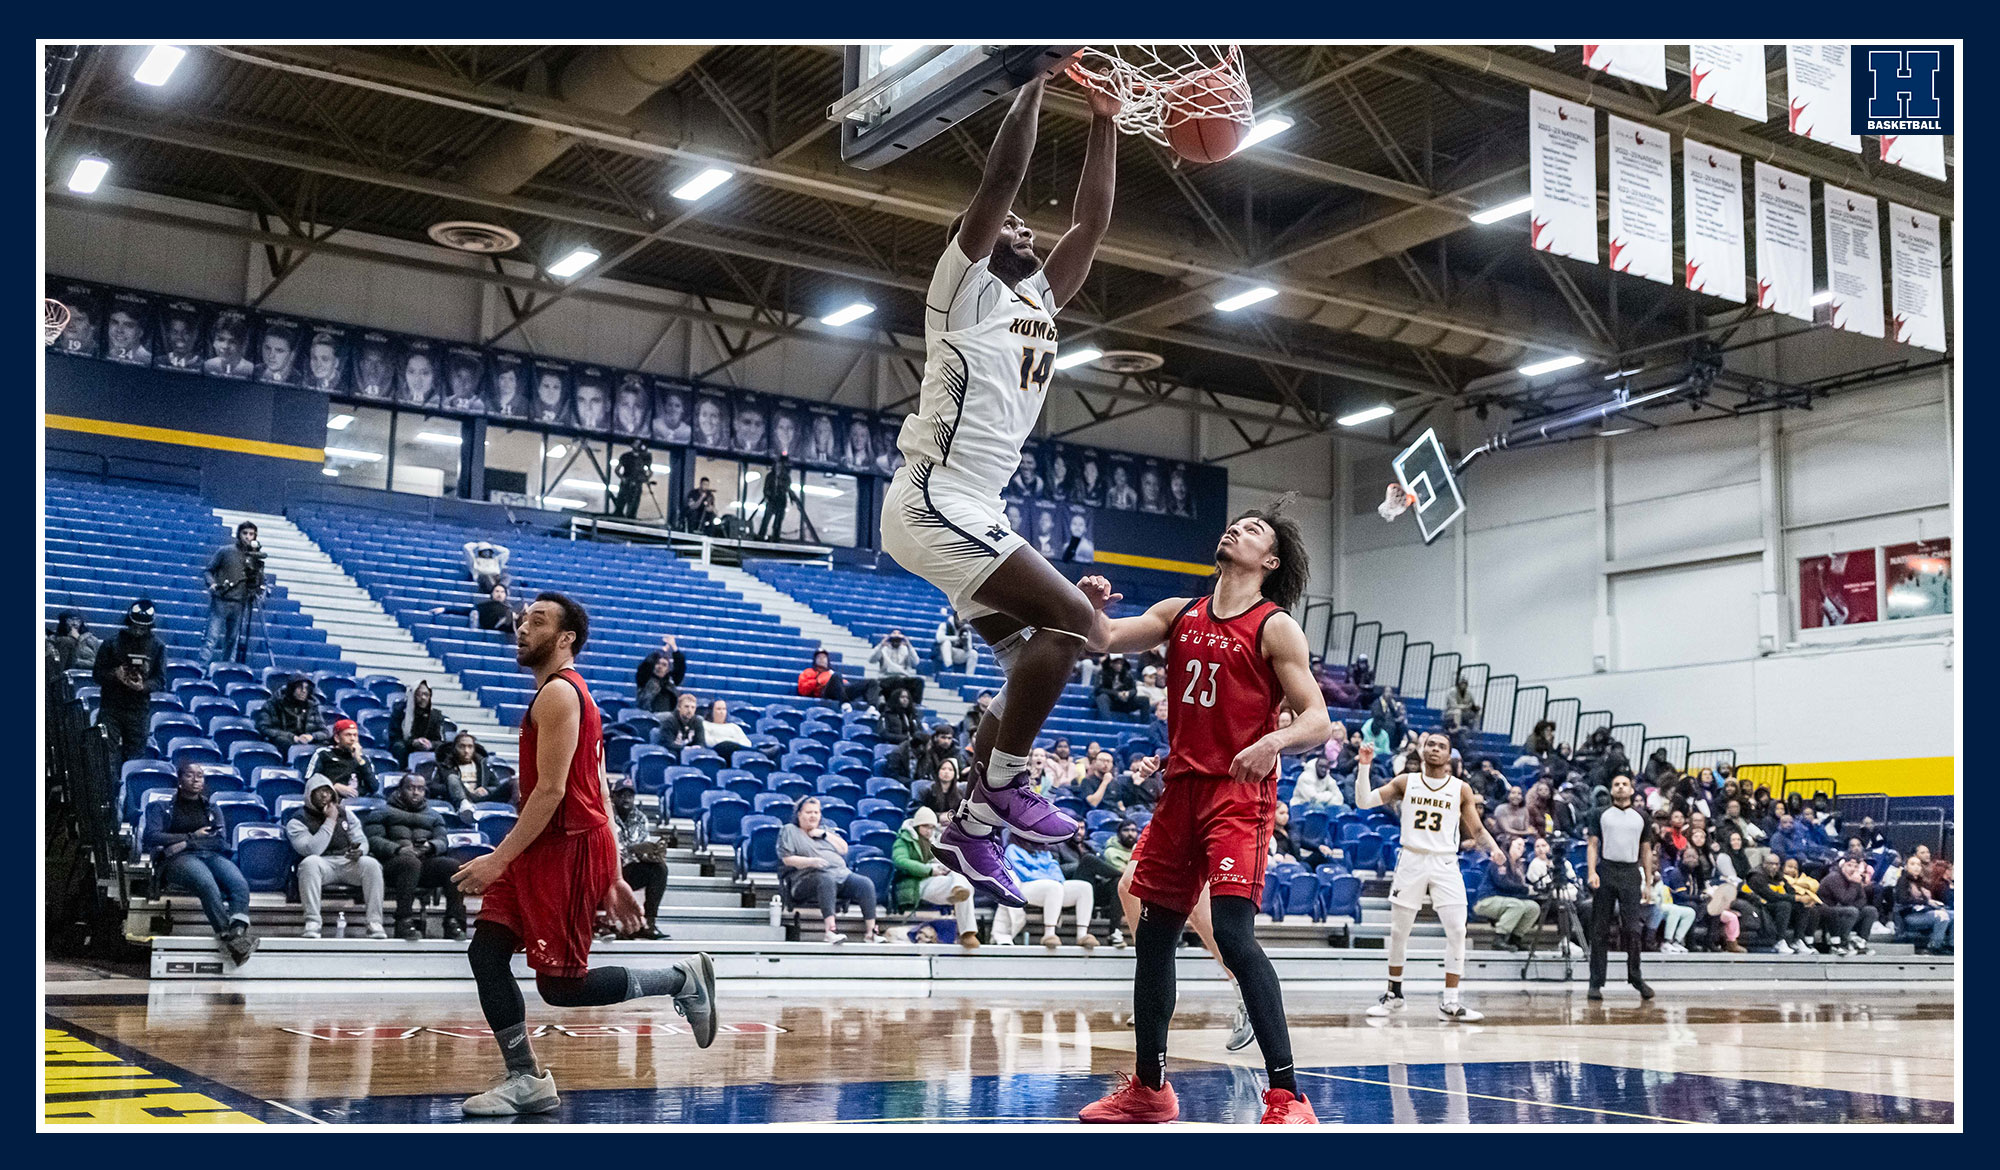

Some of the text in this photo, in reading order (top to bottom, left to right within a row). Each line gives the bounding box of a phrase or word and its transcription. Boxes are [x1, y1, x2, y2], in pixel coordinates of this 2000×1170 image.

[1009, 318, 1058, 342] HUMB
[118, 348, 133, 359] 24
[1020, 345, 1055, 393] 14
[1180, 633, 1242, 652] SURGE
[1181, 659, 1220, 708] 23
[1411, 796, 1452, 809] HUMBER
[1414, 810, 1443, 832] 23
